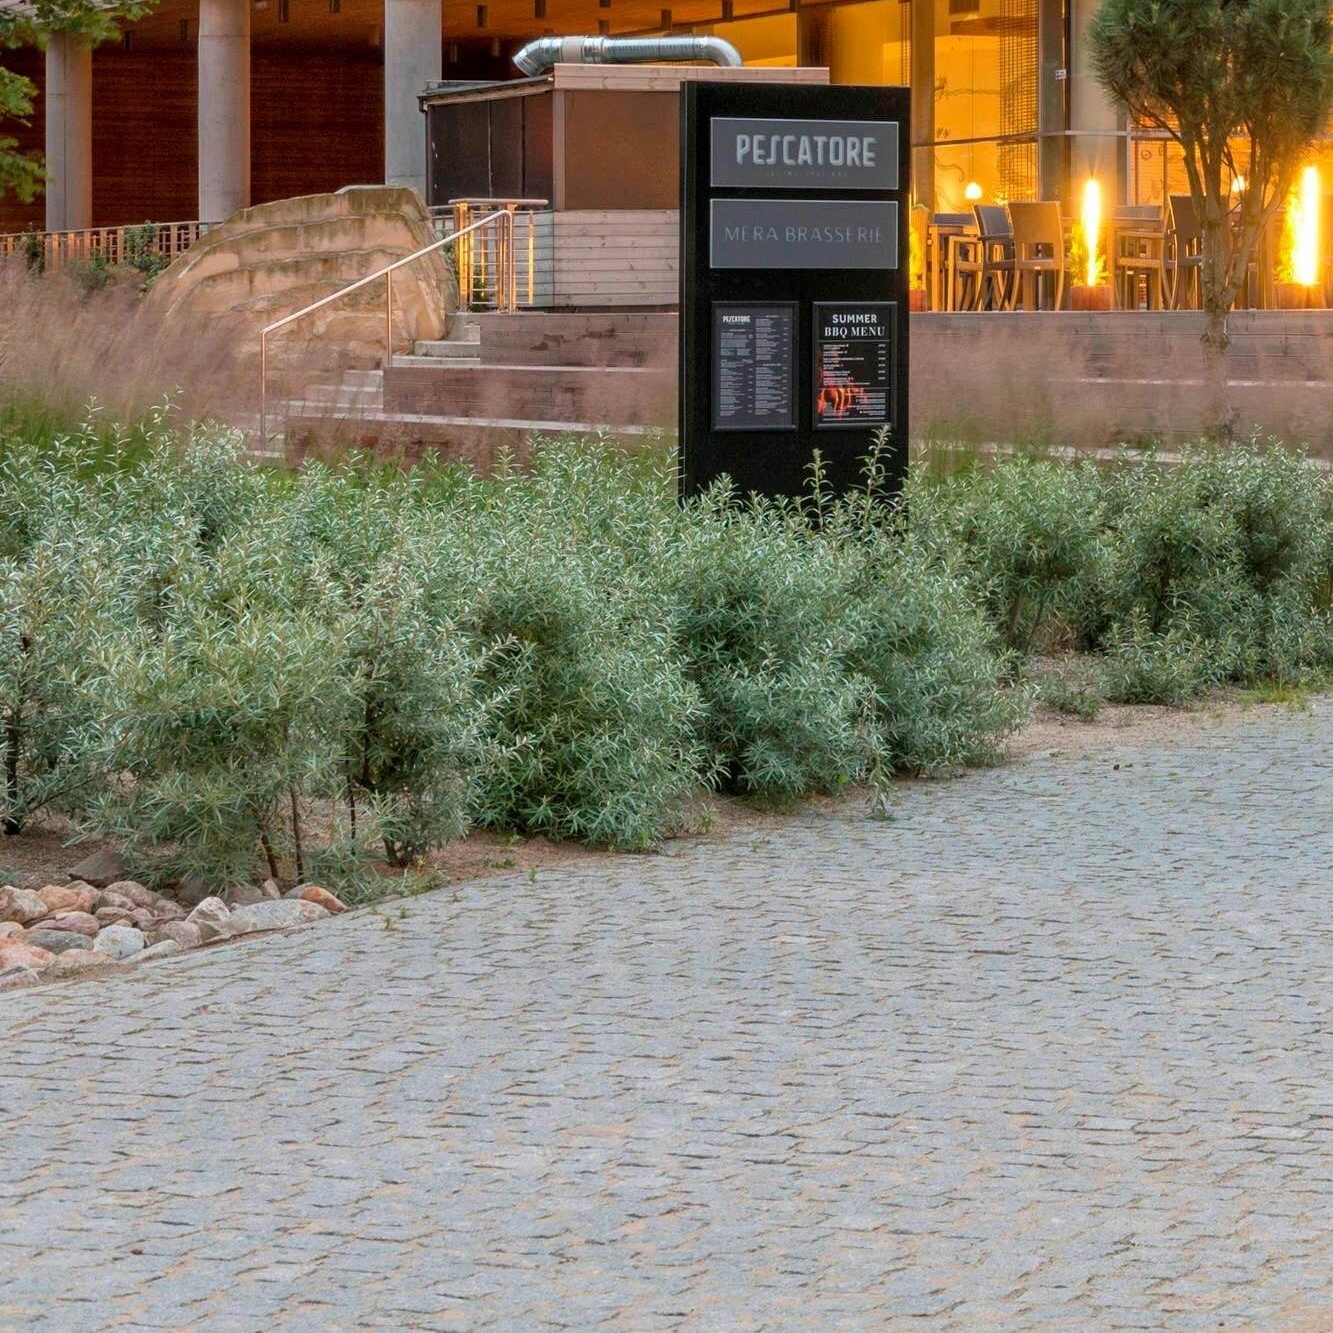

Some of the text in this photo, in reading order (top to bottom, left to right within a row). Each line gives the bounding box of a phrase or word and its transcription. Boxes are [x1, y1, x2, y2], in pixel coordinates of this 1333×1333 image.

[736, 134, 876, 167] PESCATORE
[724, 226, 883, 243] MERA BRASSERIE
[722, 315, 751, 324] PESCATORE
[832, 314, 878, 324] SUMMER
[824, 326, 885, 339] BBQ MENU
